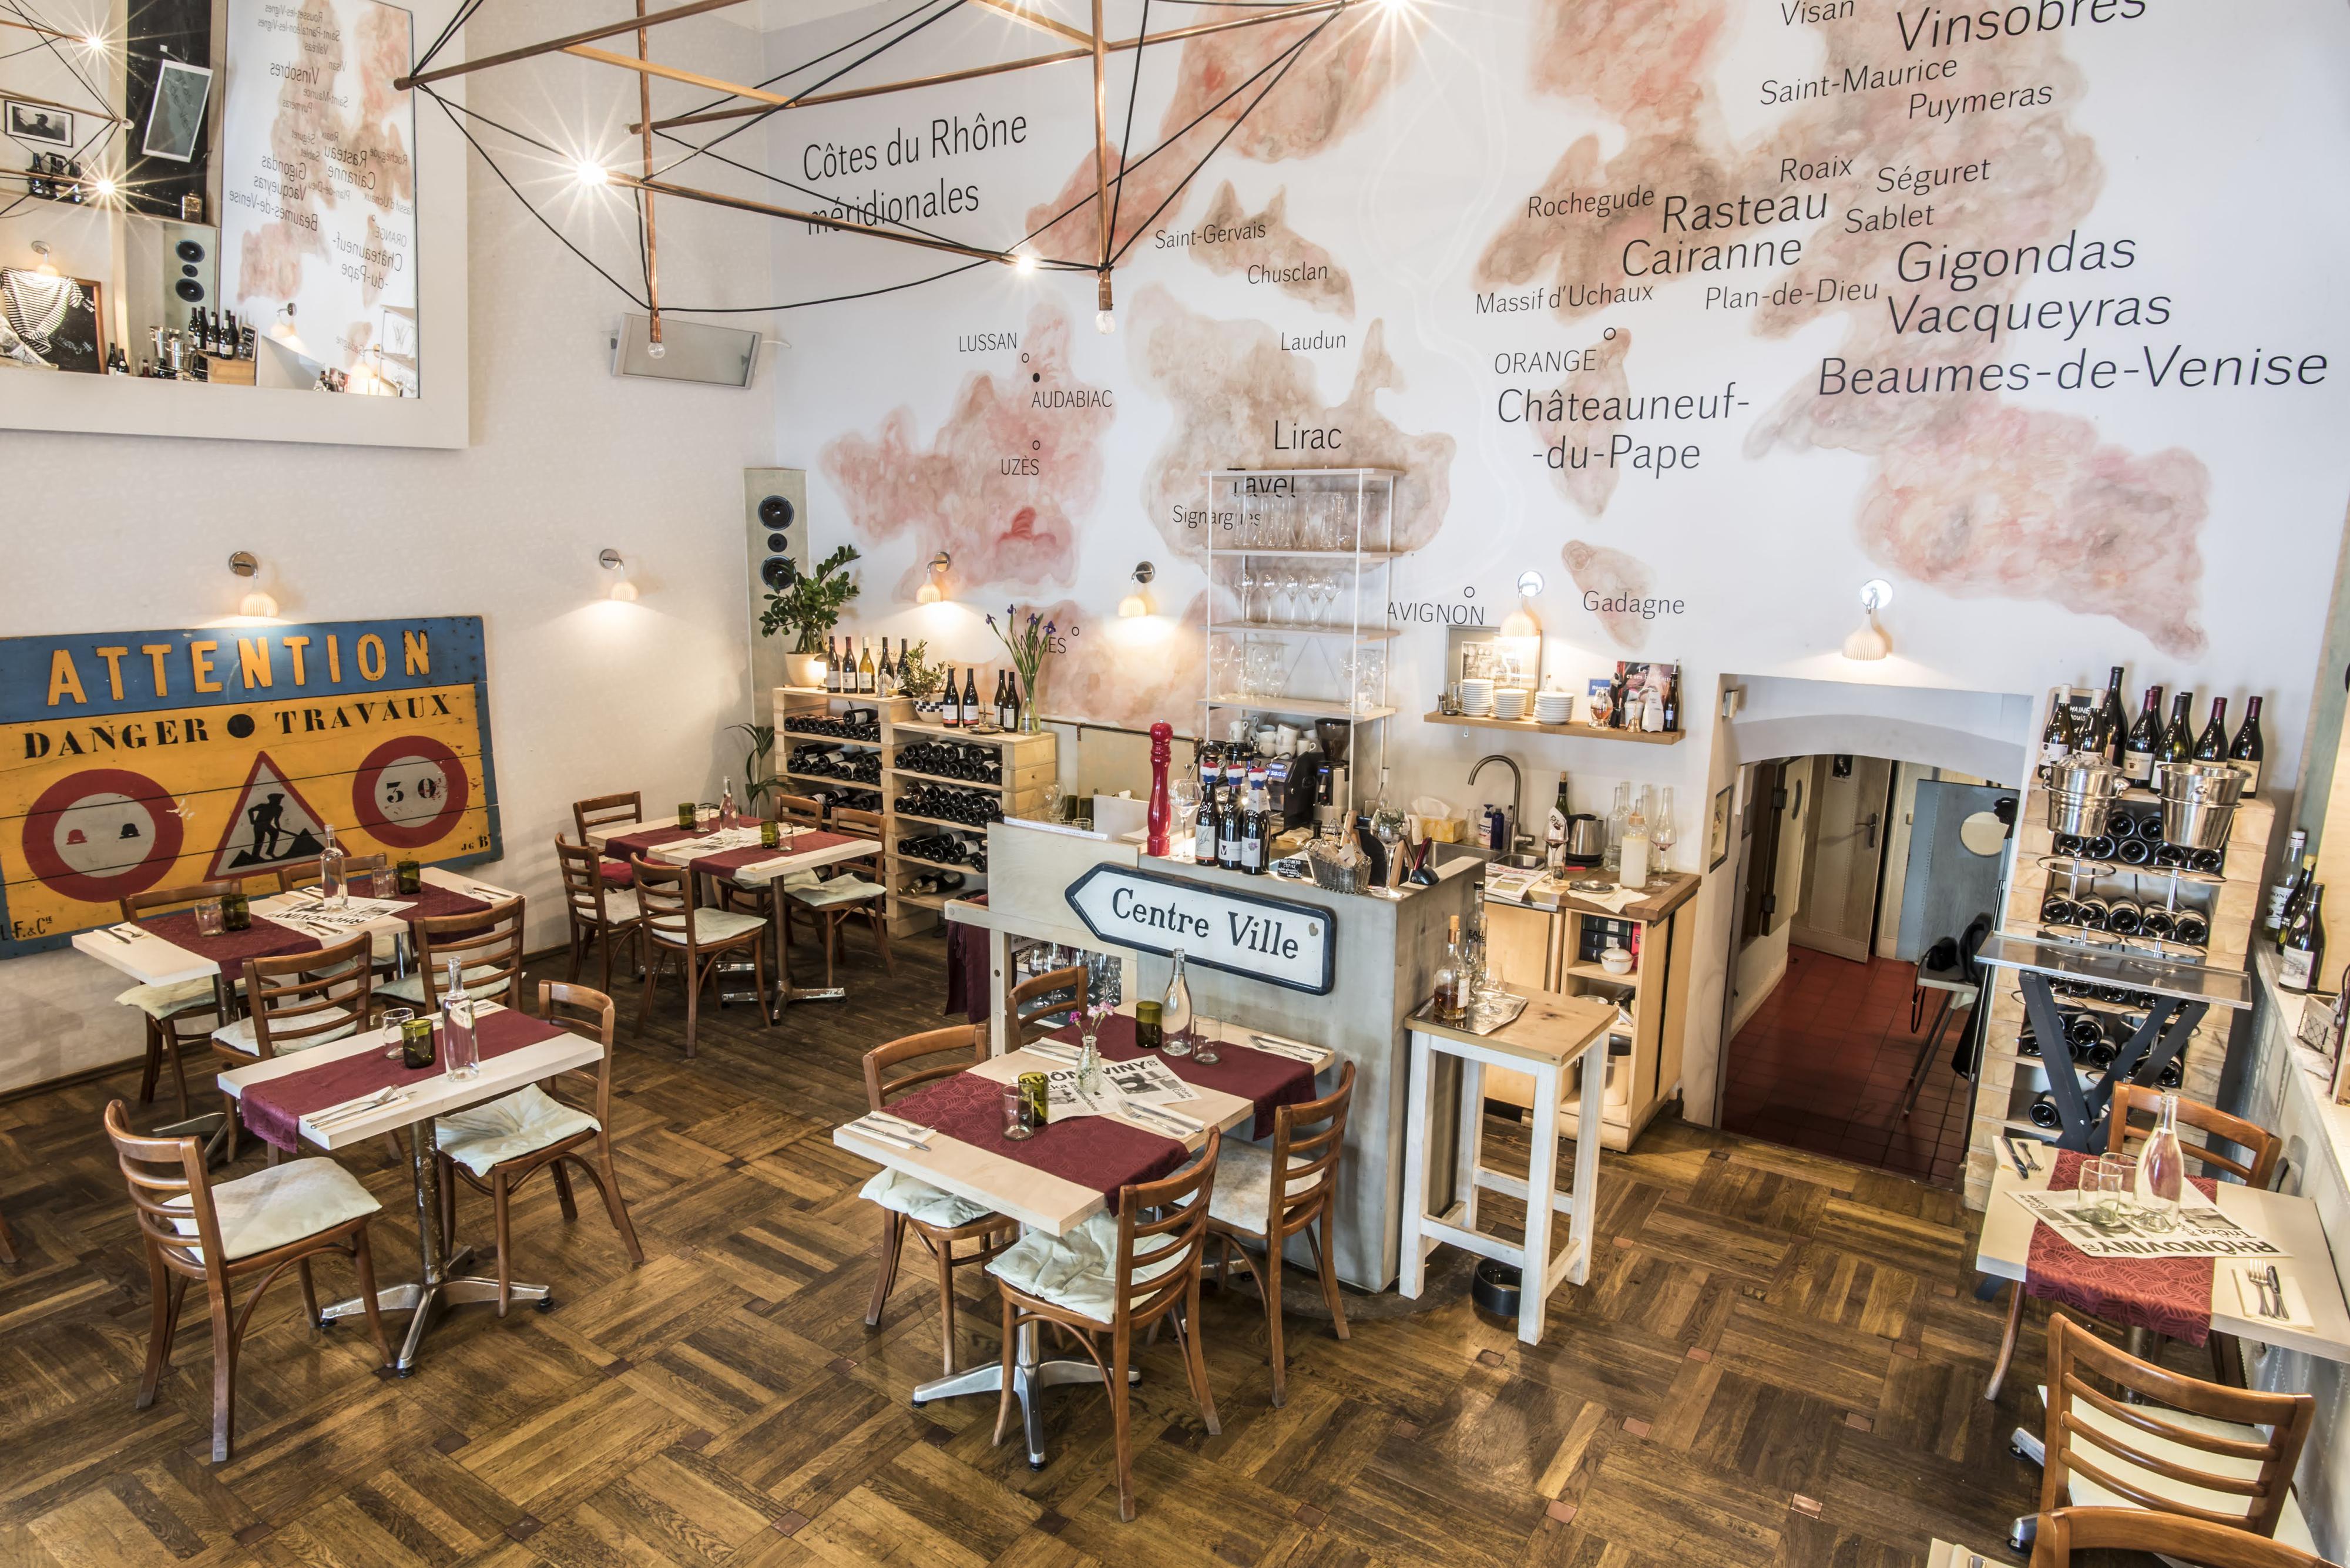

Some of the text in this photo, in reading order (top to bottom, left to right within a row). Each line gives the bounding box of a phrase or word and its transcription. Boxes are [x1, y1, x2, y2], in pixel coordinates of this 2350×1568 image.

[1781, 0, 1854, 26] Visan
[1896, 0, 2146, 52] Vinsobres
[1760, 58, 1958, 105] Saint-Maurice
[1909, 82, 2053, 124] Puymeras
[803, 113, 1028, 181] Côtes du Rhône
[1780, 156, 1854, 183] Roaix
[1876, 158, 1991, 195] Séguret
[808, 178, 979, 235] méridionales
[1528, 184, 1655, 218] Rochegude
[1663, 193, 1828, 233] Rasteau
[1845, 203, 1935, 233] Sablet
[1154, 221, 1267, 249] Saint-Gervais
[1247, 262, 1328, 284] Chusclan
[1622, 239, 1802, 277] Cairanne
[1897, 230, 2136, 292] Gigondas
[1475, 284, 1654, 314] Massif d'Uchaux
[1706, 279, 1878, 310] Plan-de-Dieu
[1886, 294, 2171, 343] Vacqueyras
[959, 332, 1018, 353] LUSSAN
[1280, 331, 1347, 351] Laudun
[1494, 350, 1597, 374] ORANGE
[1818, 344, 2328, 395] Beaumes-de-Venise
[1031, 390, 1113, 409] AUDABIAC
[1498, 381, 1750, 422] Châteauneuf-
[1274, 419, 1343, 450] Lirac
[1001, 458, 1040, 476] UZÈS
[1533, 434, 1701, 479] -du-Pape
[1388, 601, 1485, 626] AVIGNON
[1583, 590, 1685, 619] Gadagne
[47, 629, 431, 706] ATTENTION
[23, 693, 452, 760] DANGER TRAVAUX
[1112, 887, 1299, 960] Centre Ville
